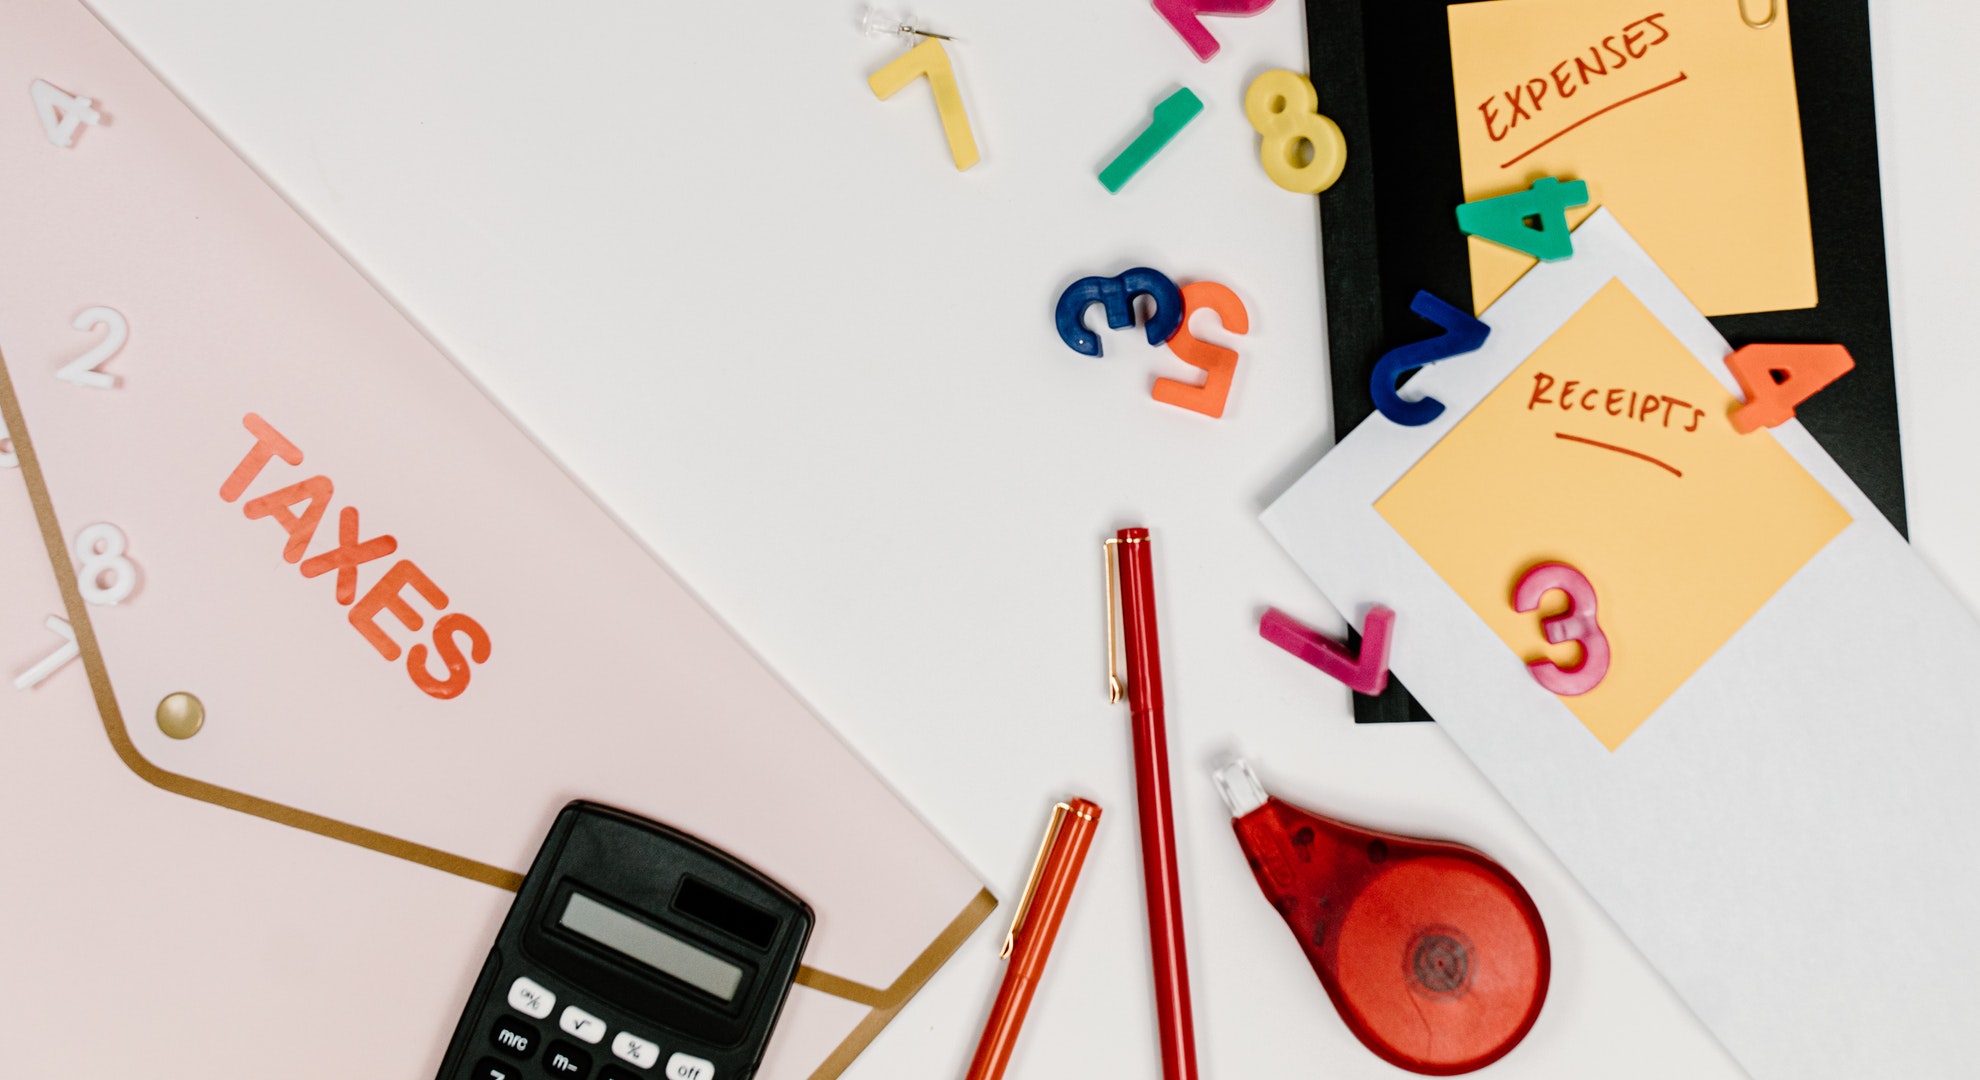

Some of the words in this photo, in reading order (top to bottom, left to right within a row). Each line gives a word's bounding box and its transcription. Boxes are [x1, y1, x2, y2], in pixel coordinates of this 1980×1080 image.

[868, 37, 981, 172] 7
[1245, 69, 1347, 194] 8
[1477, 12, 1671, 143] EXPENSES
[1098, 87, 1204, 195] 1
[1456, 176, 1589, 263] 4
[55, 306, 130, 390] 2
[1370, 290, 1491, 426] 2
[1723, 343, 1856, 434] 4
[1527, 372, 1706, 433] RECEIPTS
[76, 522, 136, 605] 8
[218, 411, 492, 700] TAXES
[1512, 561, 1612, 697] 3
[498, 1028, 529, 1051] mrc
